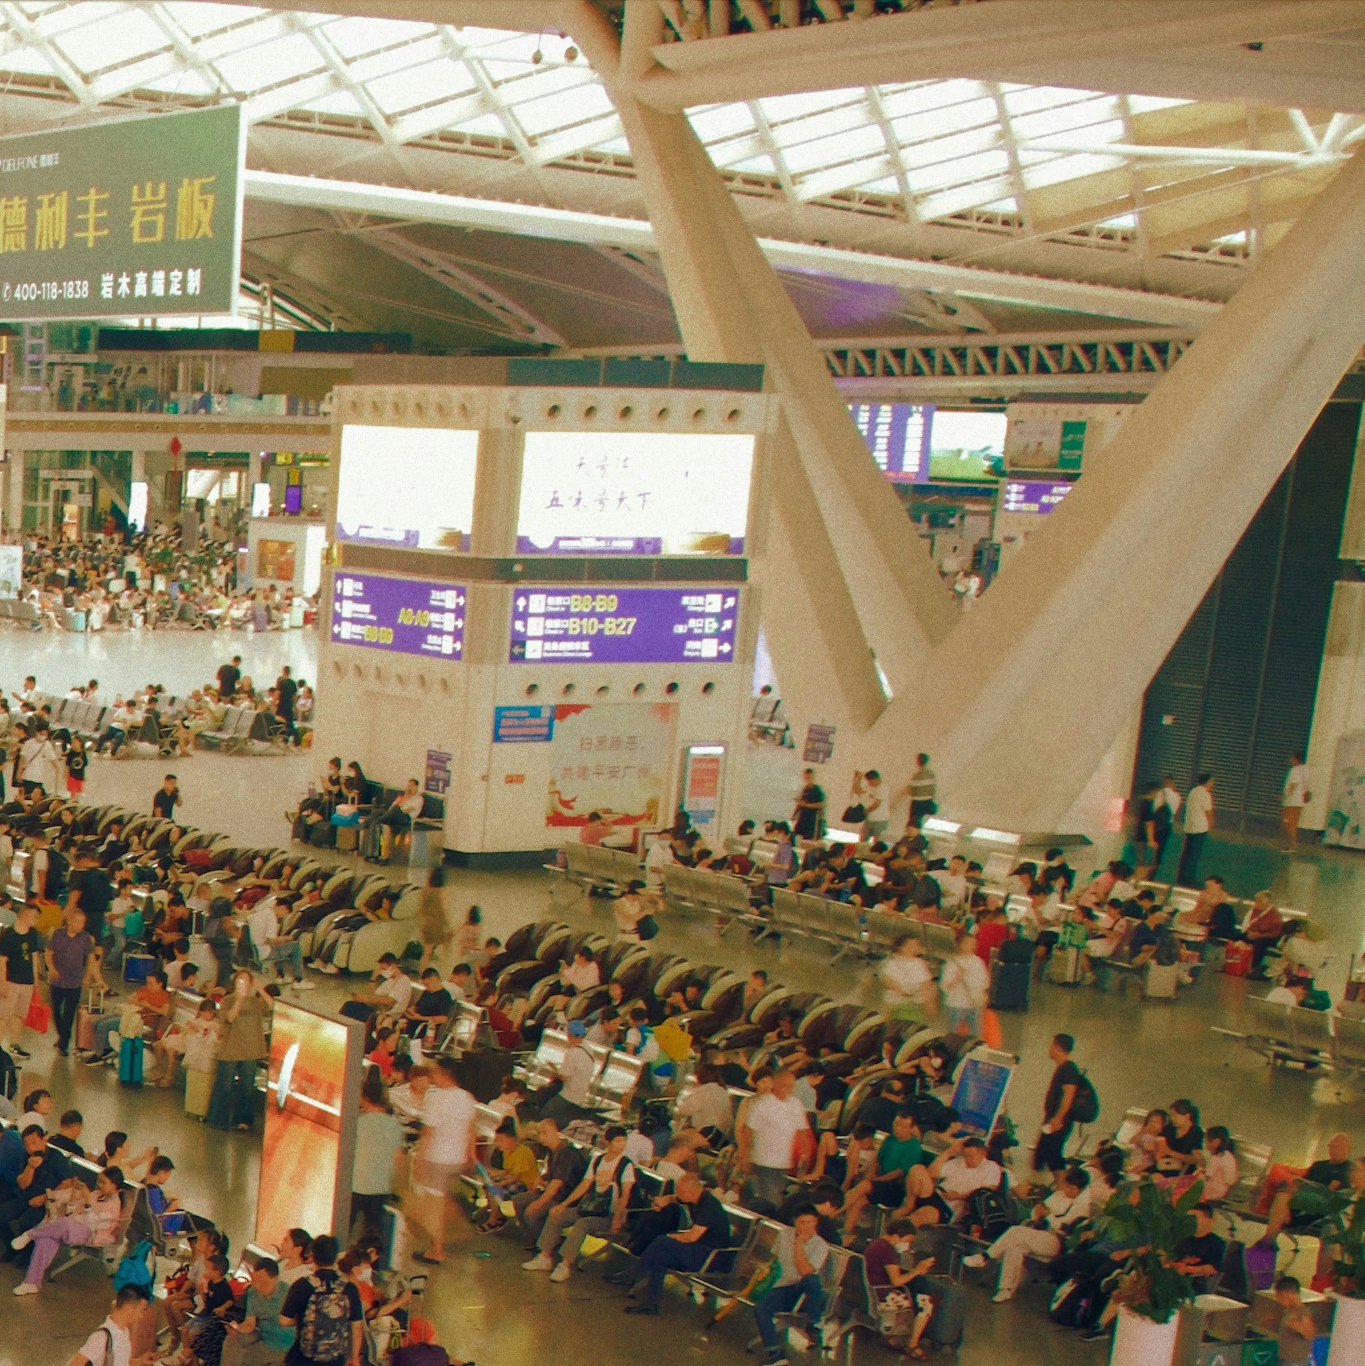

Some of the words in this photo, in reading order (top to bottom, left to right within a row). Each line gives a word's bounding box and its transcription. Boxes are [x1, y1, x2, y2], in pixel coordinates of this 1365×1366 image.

[130, 176, 216, 243] 岩板
[14, 281, 89, 301] 400-118-1838
[100, 268, 201, 299] 岩木高端定制
[570, 594, 618, 612] B8-B9
[568, 617, 637, 636] B10-B27
